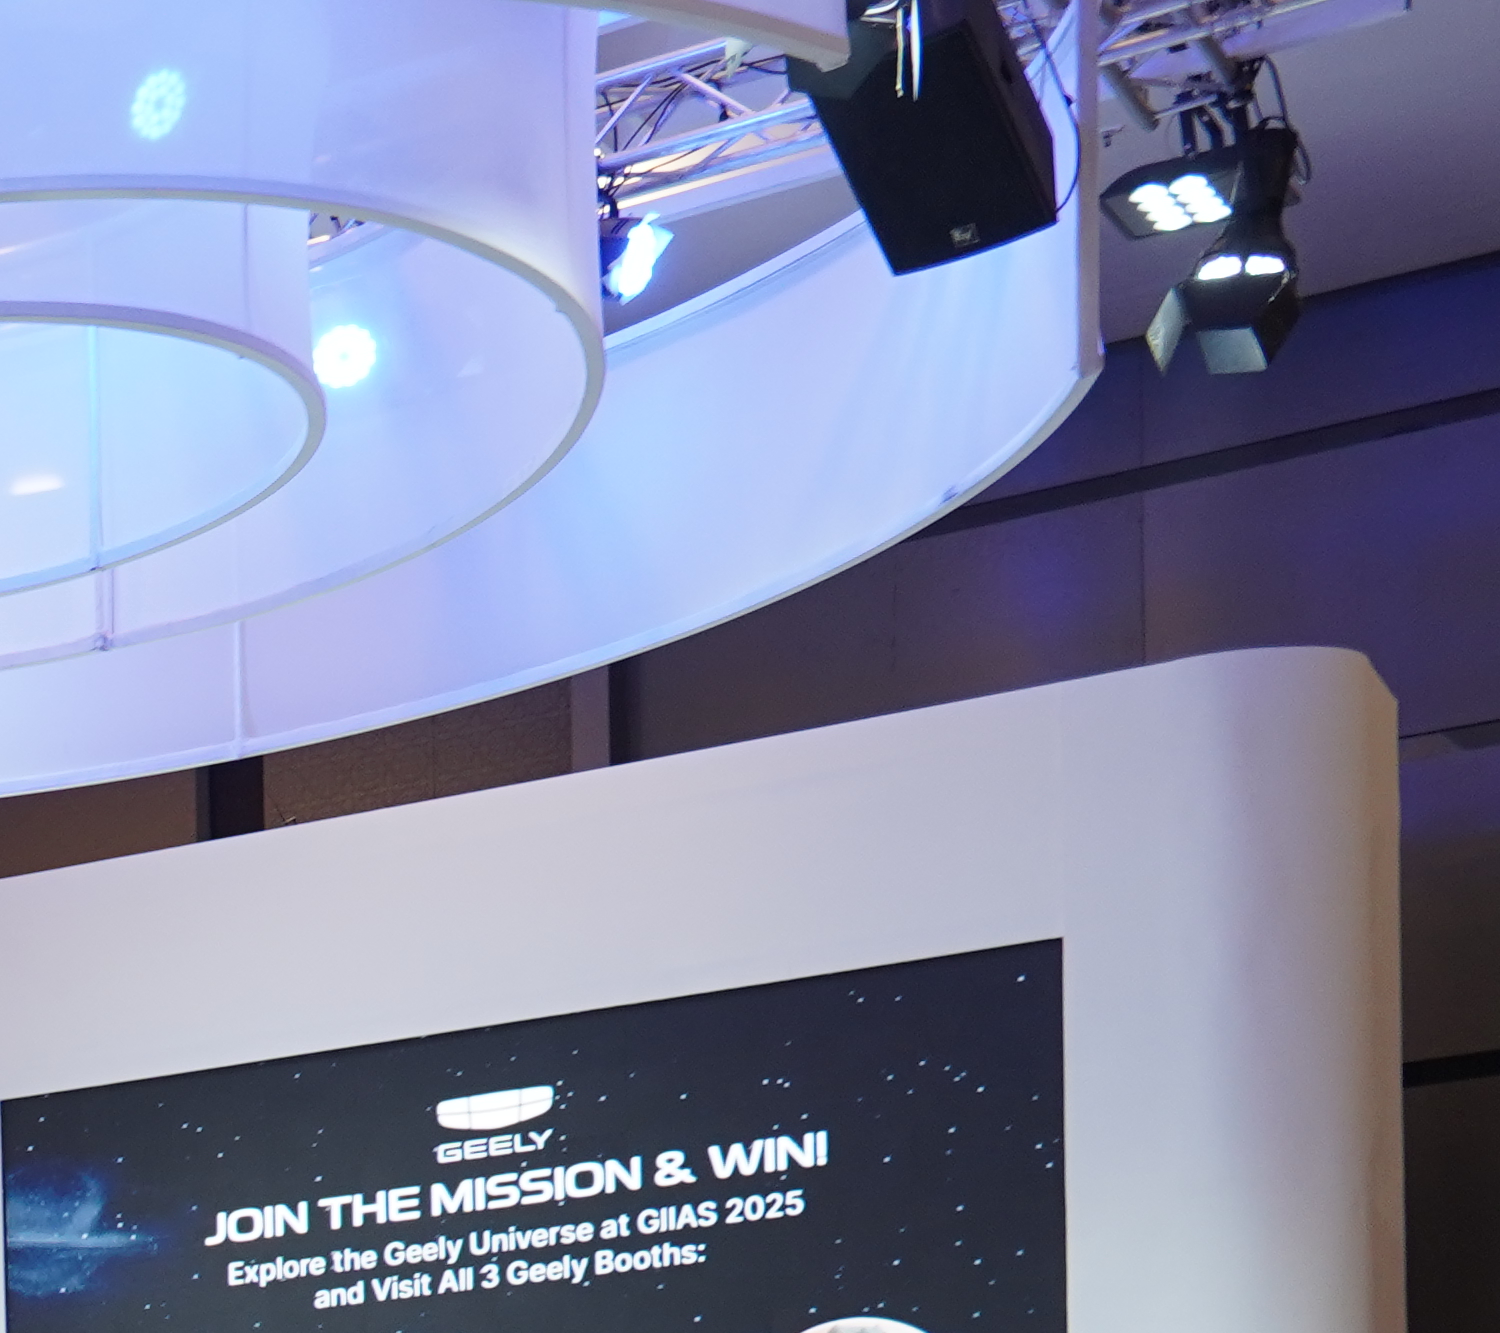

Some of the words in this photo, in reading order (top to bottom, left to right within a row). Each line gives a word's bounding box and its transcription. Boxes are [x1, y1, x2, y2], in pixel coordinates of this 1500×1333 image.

[205, 1200, 308, 1247] JOIN
[318, 1185, 422, 1231] THE
[430, 1158, 642, 1215] MISSION
[653, 1149, 697, 1188] &
[708, 1129, 829, 1179] WIN!
[436, 1128, 554, 1164] GEELY
[227, 1250, 327, 1288] Explore
[332, 1242, 378, 1273] the
[384, 1231, 464, 1269] Geely
[469, 1217, 595, 1258] Universe
[600, 1212, 631, 1240] at
[637, 1203, 718, 1237] GIIAS
[725, 1188, 805, 1225] 2025
[313, 1278, 365, 1310] and
[370, 1268, 431, 1303] Visit
[438, 1260, 475, 1295] All
[480, 1260, 501, 1290] 3
[506, 1246, 590, 1288] Geely
[595, 1238, 707, 1276] Booths:
